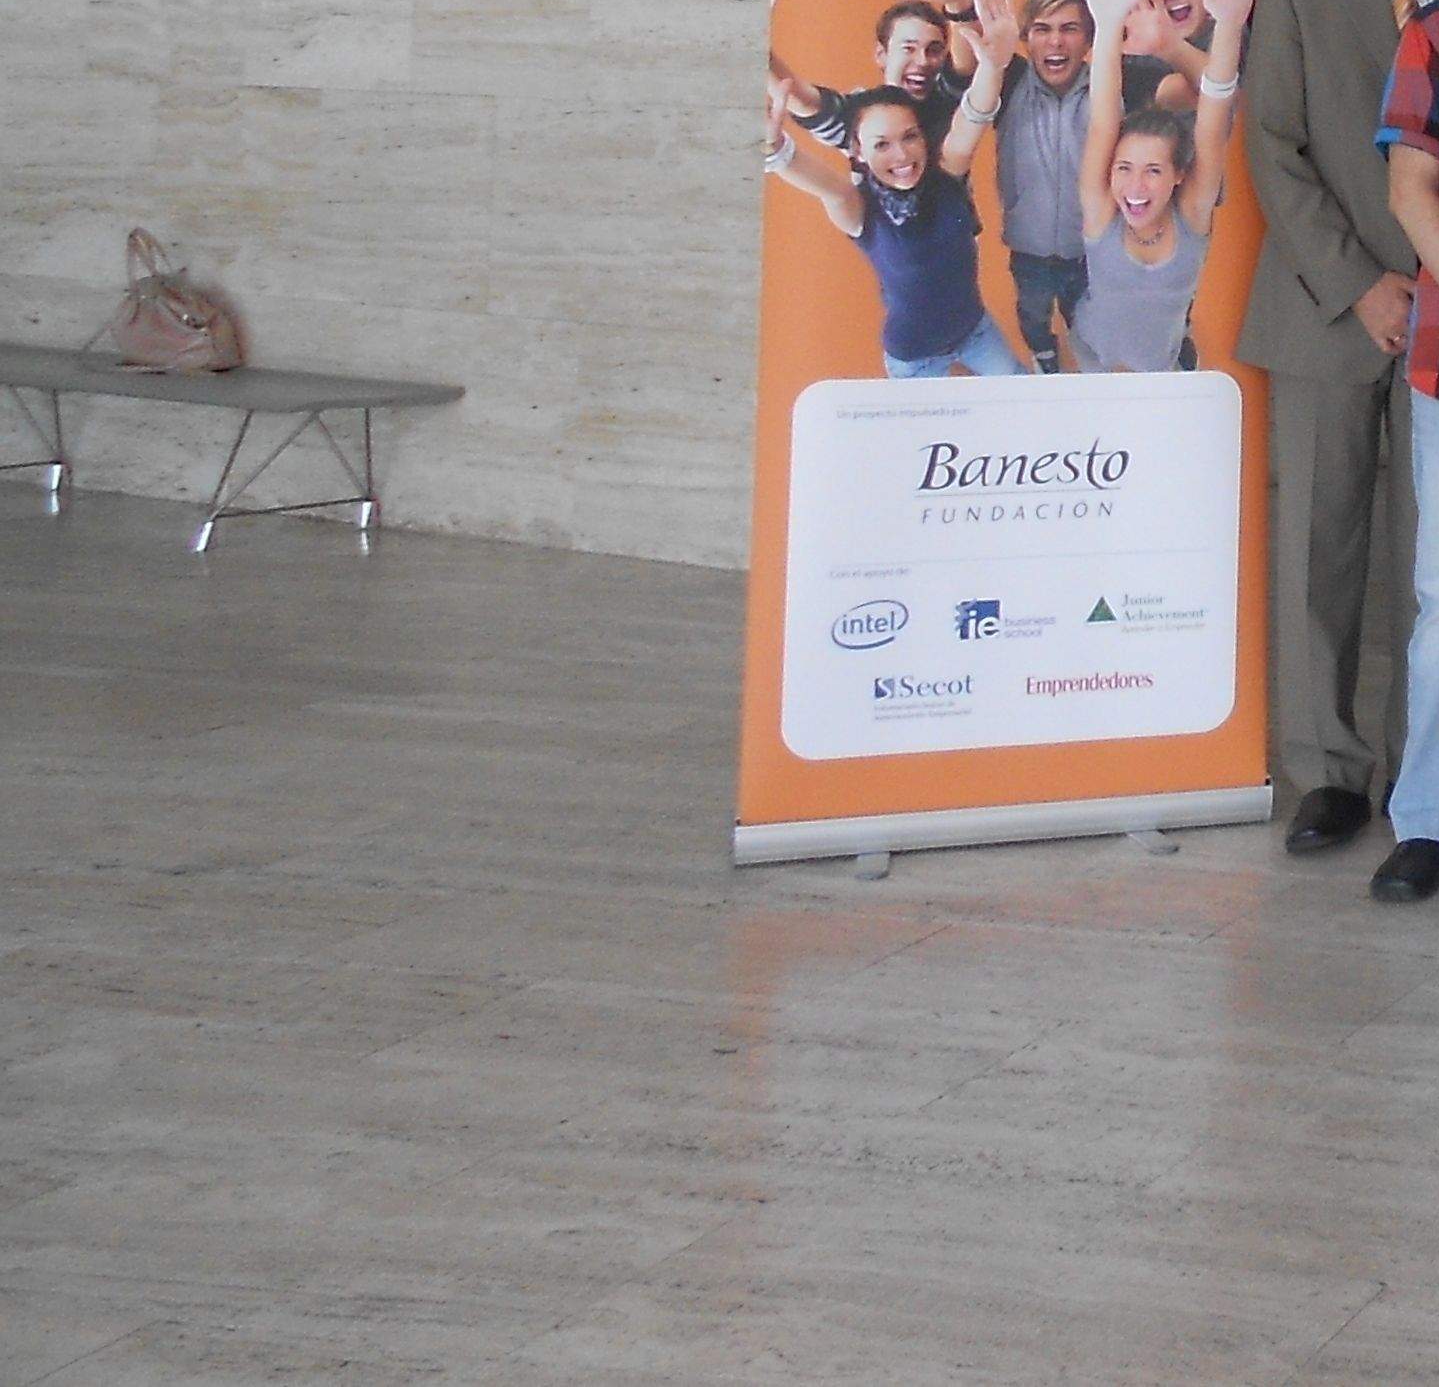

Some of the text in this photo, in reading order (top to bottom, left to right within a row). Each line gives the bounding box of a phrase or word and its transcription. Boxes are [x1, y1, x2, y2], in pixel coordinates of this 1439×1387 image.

[918, 436, 1130, 490] Banesto
[841, 610, 895, 634] intel
[968, 609, 1000, 639] ie
[898, 674, 975, 698] Secot
[1026, 671, 1155, 698] Emprendedores
